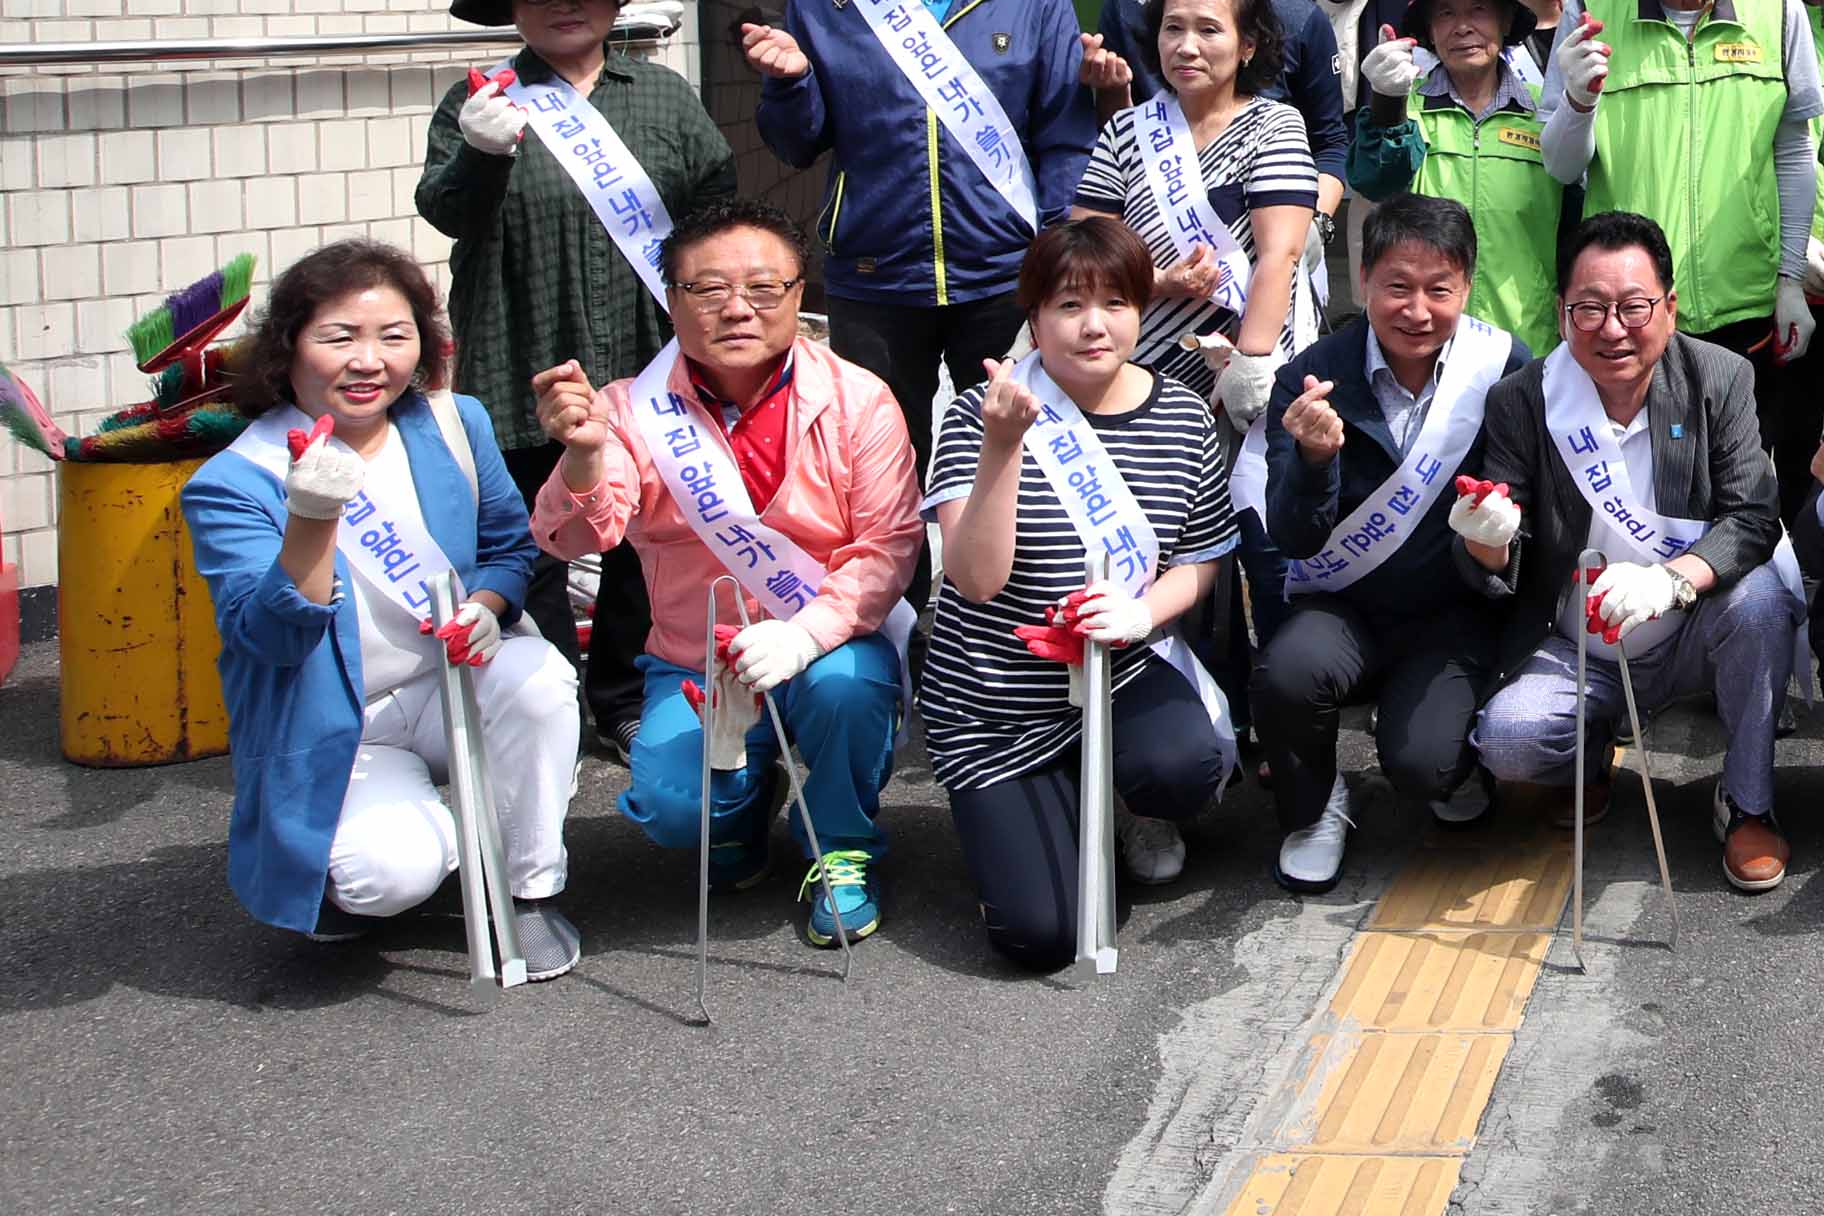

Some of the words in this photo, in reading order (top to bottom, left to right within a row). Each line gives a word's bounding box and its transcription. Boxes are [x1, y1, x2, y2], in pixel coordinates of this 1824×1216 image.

[883, 5, 912, 33] 집
[902, 30, 948, 81] 앞은
[938, 78, 985, 123] 내가
[1145, 101, 1168, 123] 내
[1149, 125, 1175, 153] 집
[531, 91, 568, 114] 내
[555, 115, 585, 140] 집
[573, 137, 625, 191] 앞은
[608, 187, 654, 237] 내가
[1159, 154, 1189, 206] 앞은
[650, 391, 688, 418] 내
[664, 425, 702, 458] 집
[679, 461, 729, 525] 앞은
[1413, 452, 1443, 486] 내
[1567, 425, 1599, 455] 내
[1584, 460, 1613, 494] 집
[1602, 495, 1657, 544] 앞은
[1048, 430, 1083, 466] 집
[1067, 464, 1118, 527] 앞은
[1102, 524, 1149, 583] 내가
[1387, 485, 1421, 518] 집
[360, 521, 421, 584] 앞은
[715, 524, 777, 569] 내가
[1340, 511, 1396, 559] 앞은
